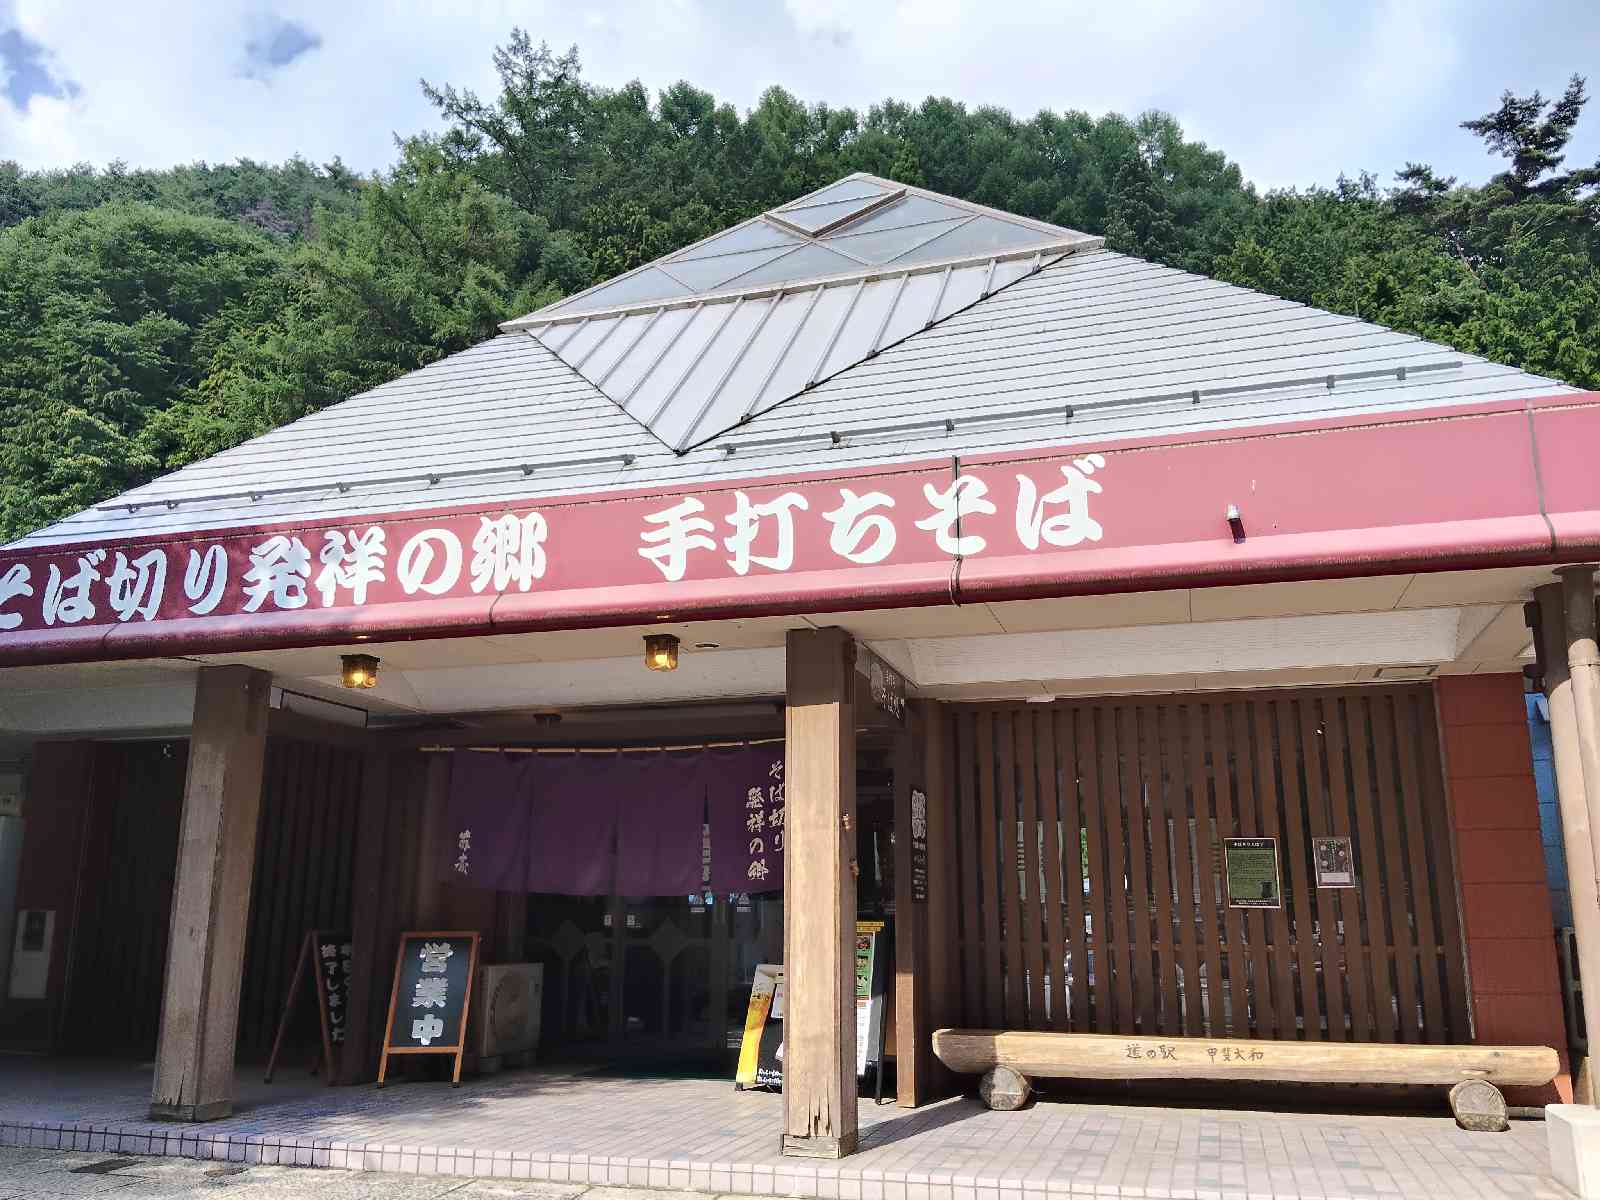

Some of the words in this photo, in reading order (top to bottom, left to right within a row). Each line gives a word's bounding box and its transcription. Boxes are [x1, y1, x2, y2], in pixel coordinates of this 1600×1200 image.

[638, 454, 1105, 582] 手打ちそば
[320, 944, 345, 1041] 終了しました
[411, 942, 454, 1045] 営業中
